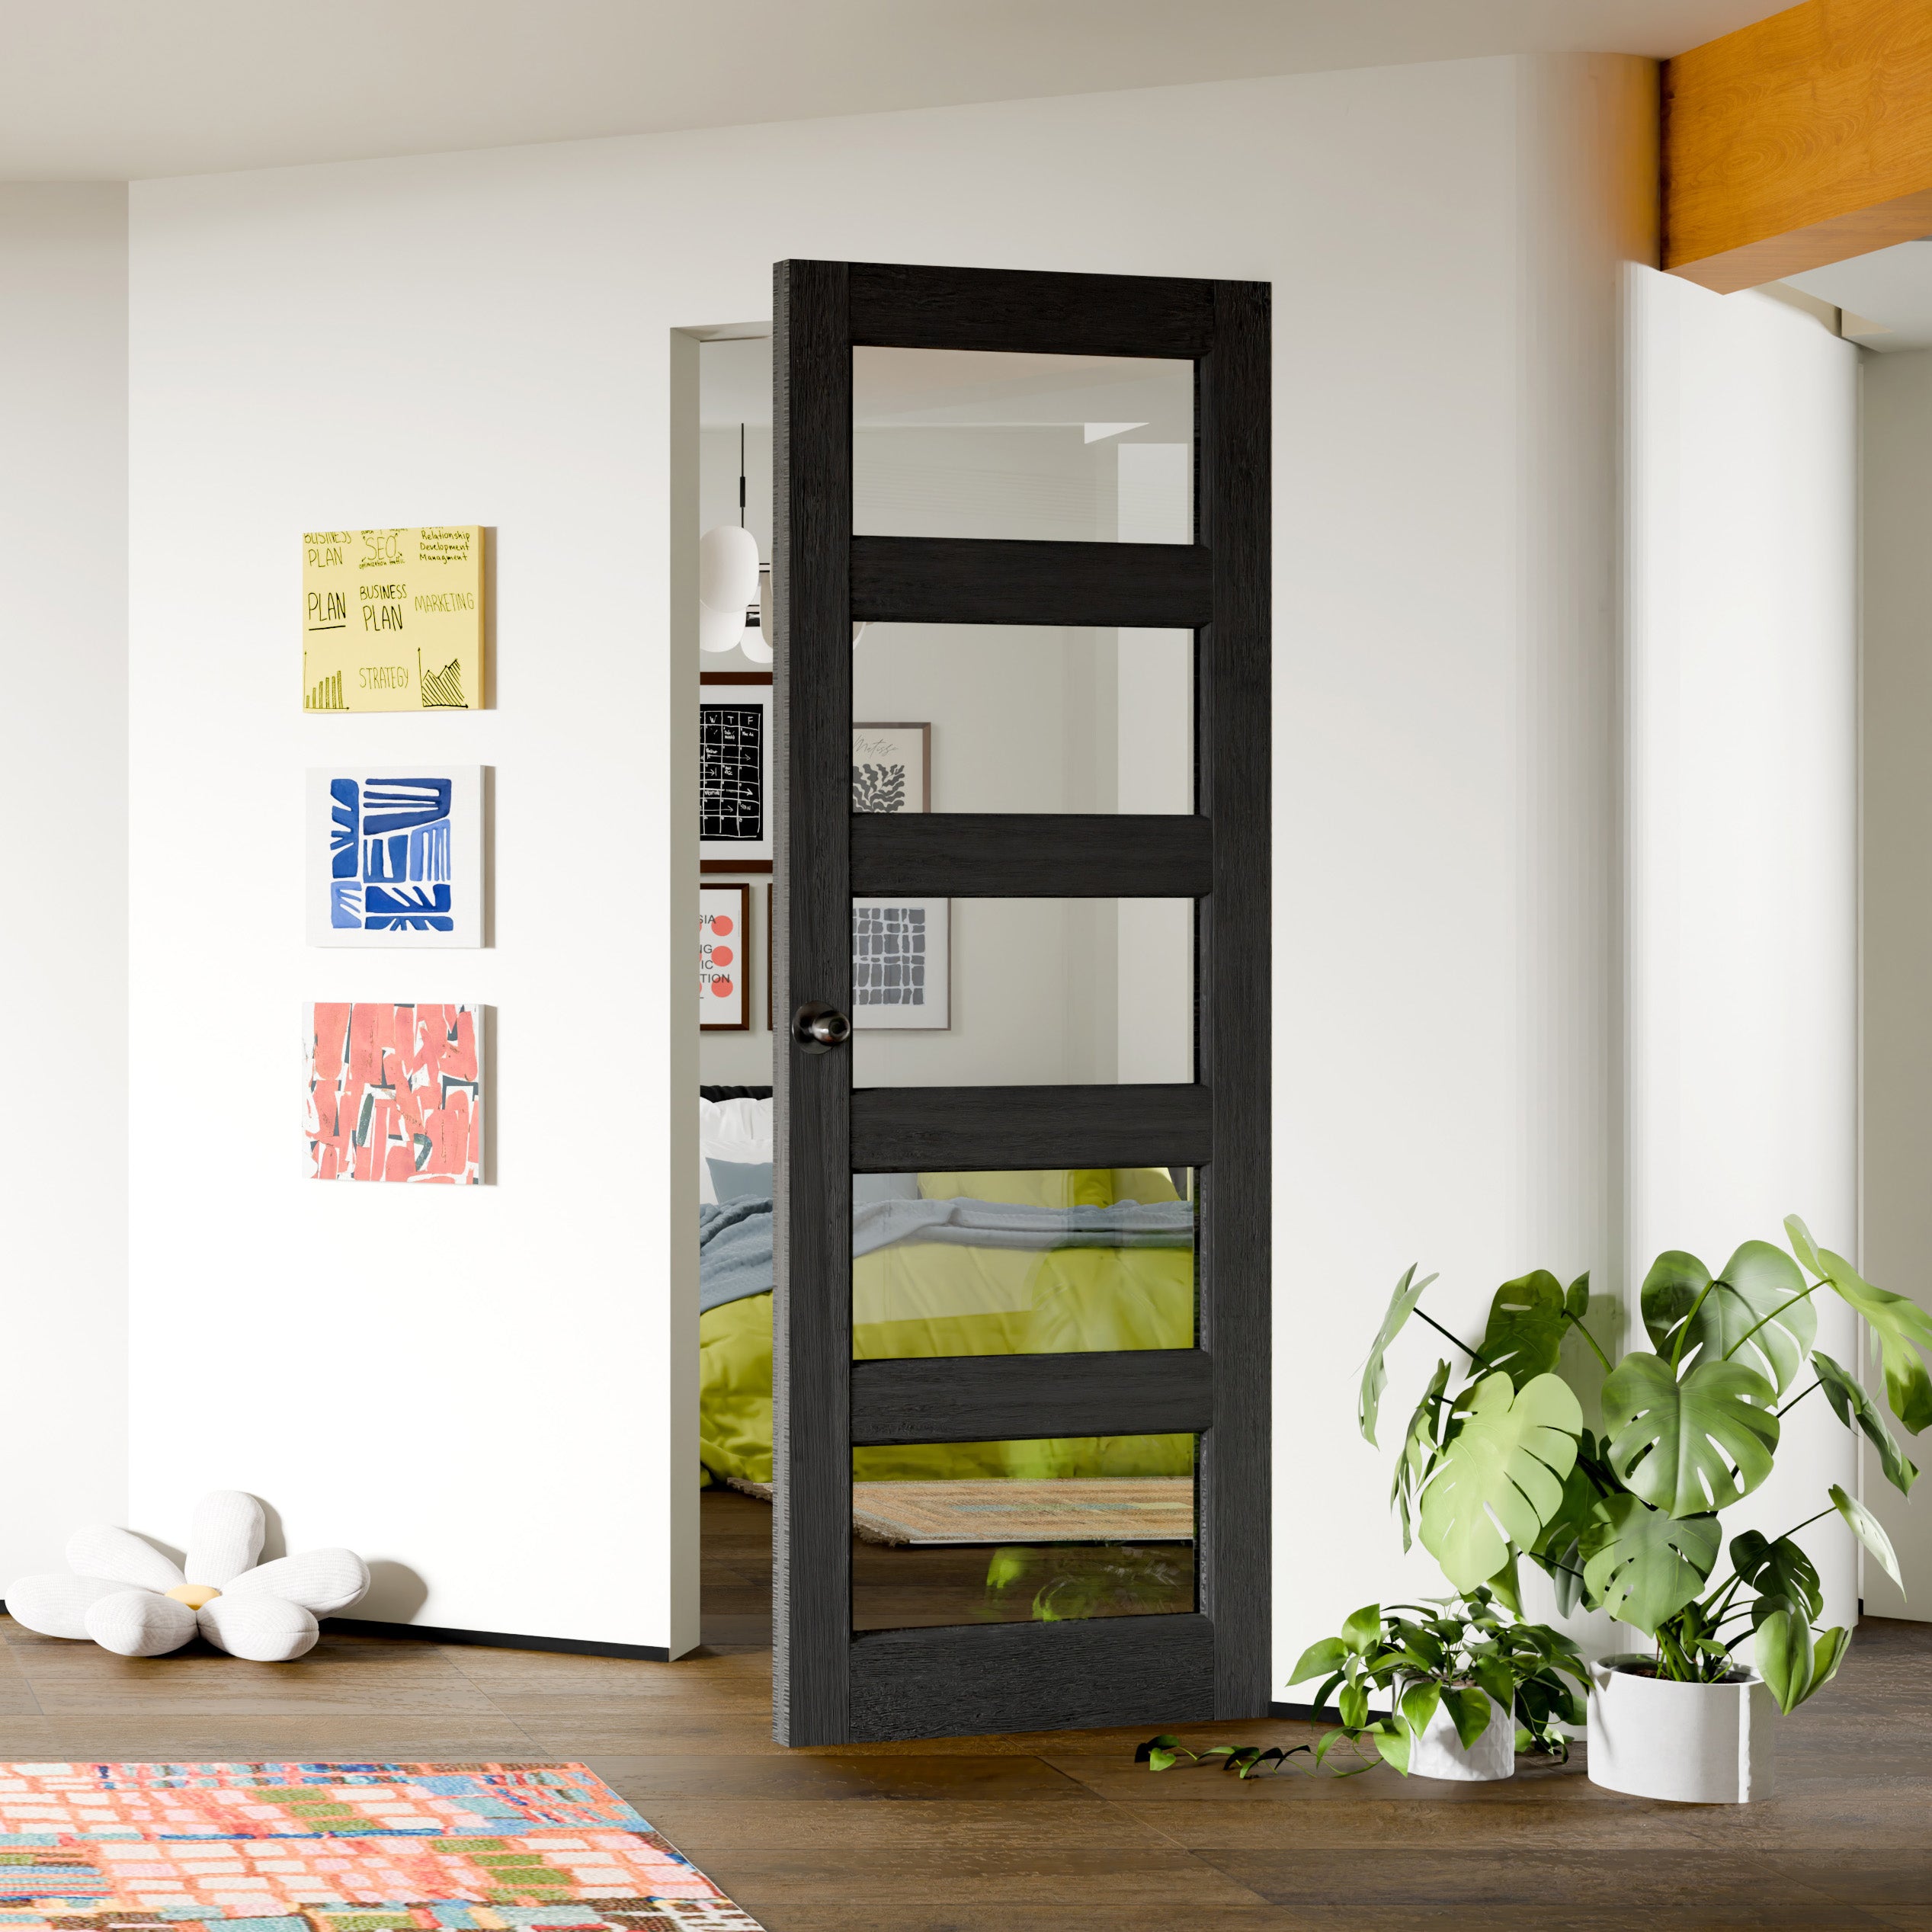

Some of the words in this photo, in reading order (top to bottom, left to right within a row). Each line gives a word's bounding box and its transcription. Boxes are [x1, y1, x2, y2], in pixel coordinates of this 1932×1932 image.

[303, 531, 352, 544] BUSINESS
[421, 530, 470, 543] Relationship
[366, 535, 396, 561] SEO
[420, 541, 469, 554] Development
[308, 546, 343, 568] PLAN
[419, 552, 467, 565] Managment
[360, 584, 408, 601] BUSINESS
[308, 591, 347, 622] PLAN
[415, 592, 475, 614] MARKETING
[363, 604, 403, 632] PLAN
[359, 666, 409, 690] STRATEGY
[709, 714, 718, 724] W
[727, 716, 735, 725] T
[748, 716, 754, 726] F
